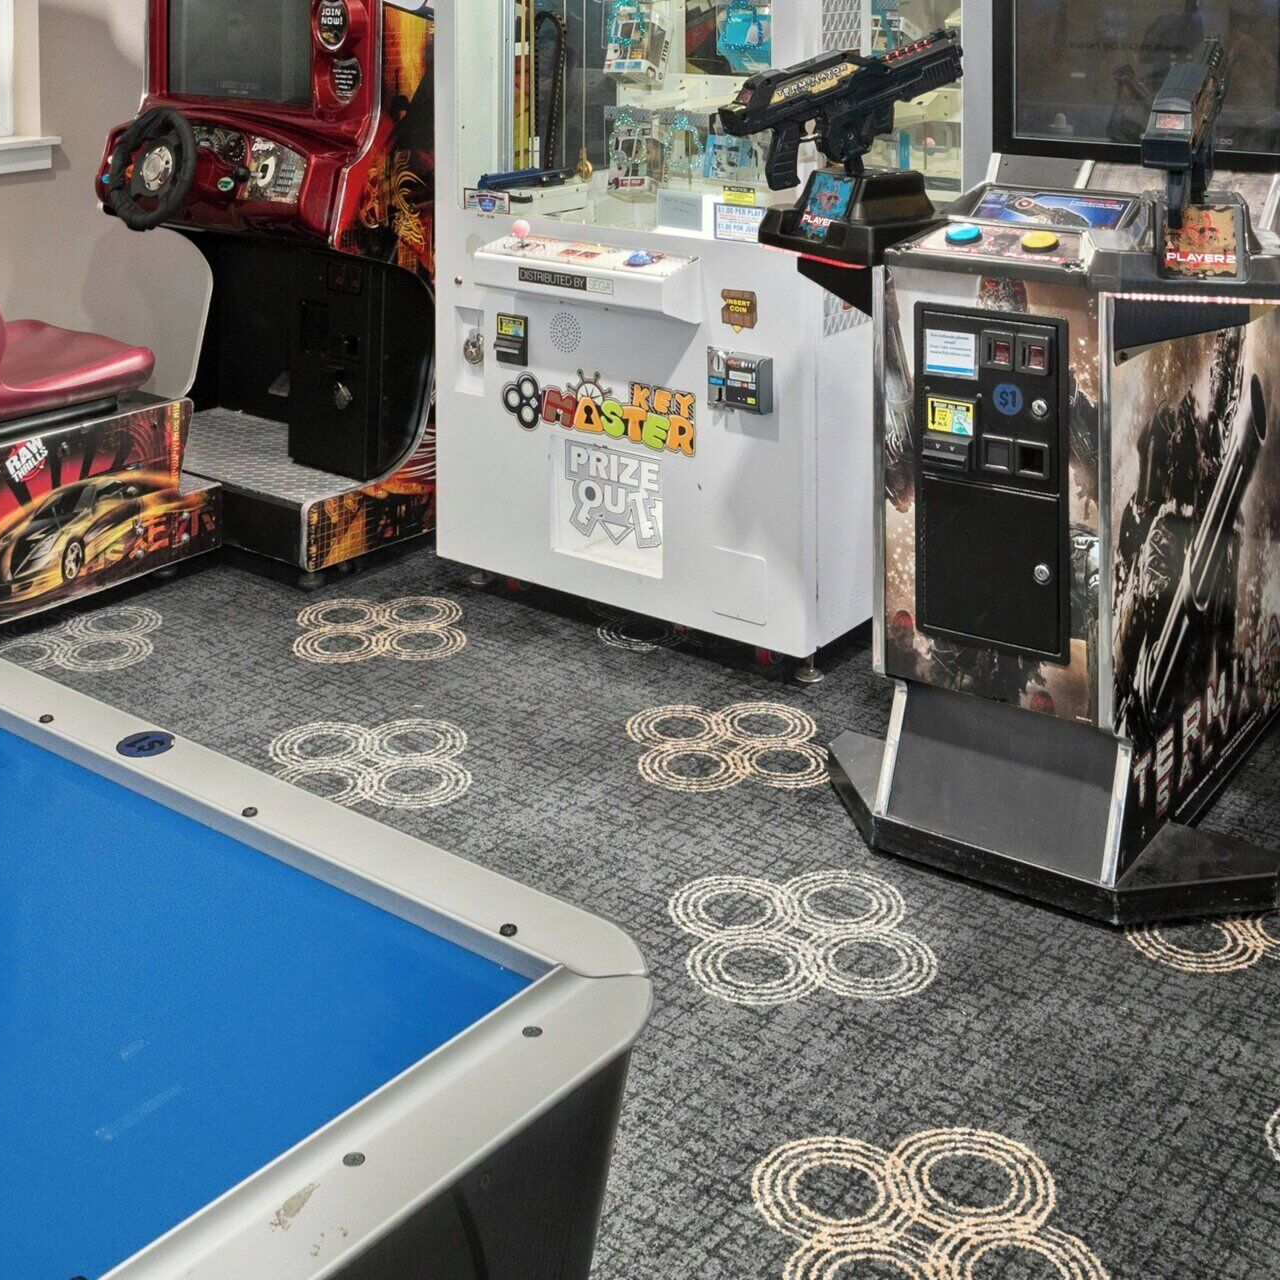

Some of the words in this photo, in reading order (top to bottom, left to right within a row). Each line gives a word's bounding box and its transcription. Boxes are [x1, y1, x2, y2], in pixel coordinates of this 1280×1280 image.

[321, 8, 341, 16] JOIN
[321, 16, 343, 26] NOW!
[662, 39, 670, 63] BELLE
[776, 63, 848, 97] TERMINATOR
[718, 206, 733, 215] $1.00
[735, 207, 746, 215] PER
[718, 223, 732, 231] $1.00
[519, 269, 573, 287] DISTRIBUTED
[573, 277, 585, 288] BY
[588, 279, 612, 292] SEGA
[725, 298, 751, 307] INSERT
[729, 305, 748, 314] COIN
[631, 383, 696, 419] KEY
[998, 386, 1017, 409] $1
[541, 387, 696, 457] MASTER
[5, 437, 44, 475] RAW
[13, 446, 49, 483] THRILLS
[568, 443, 661, 492] PRIZE
